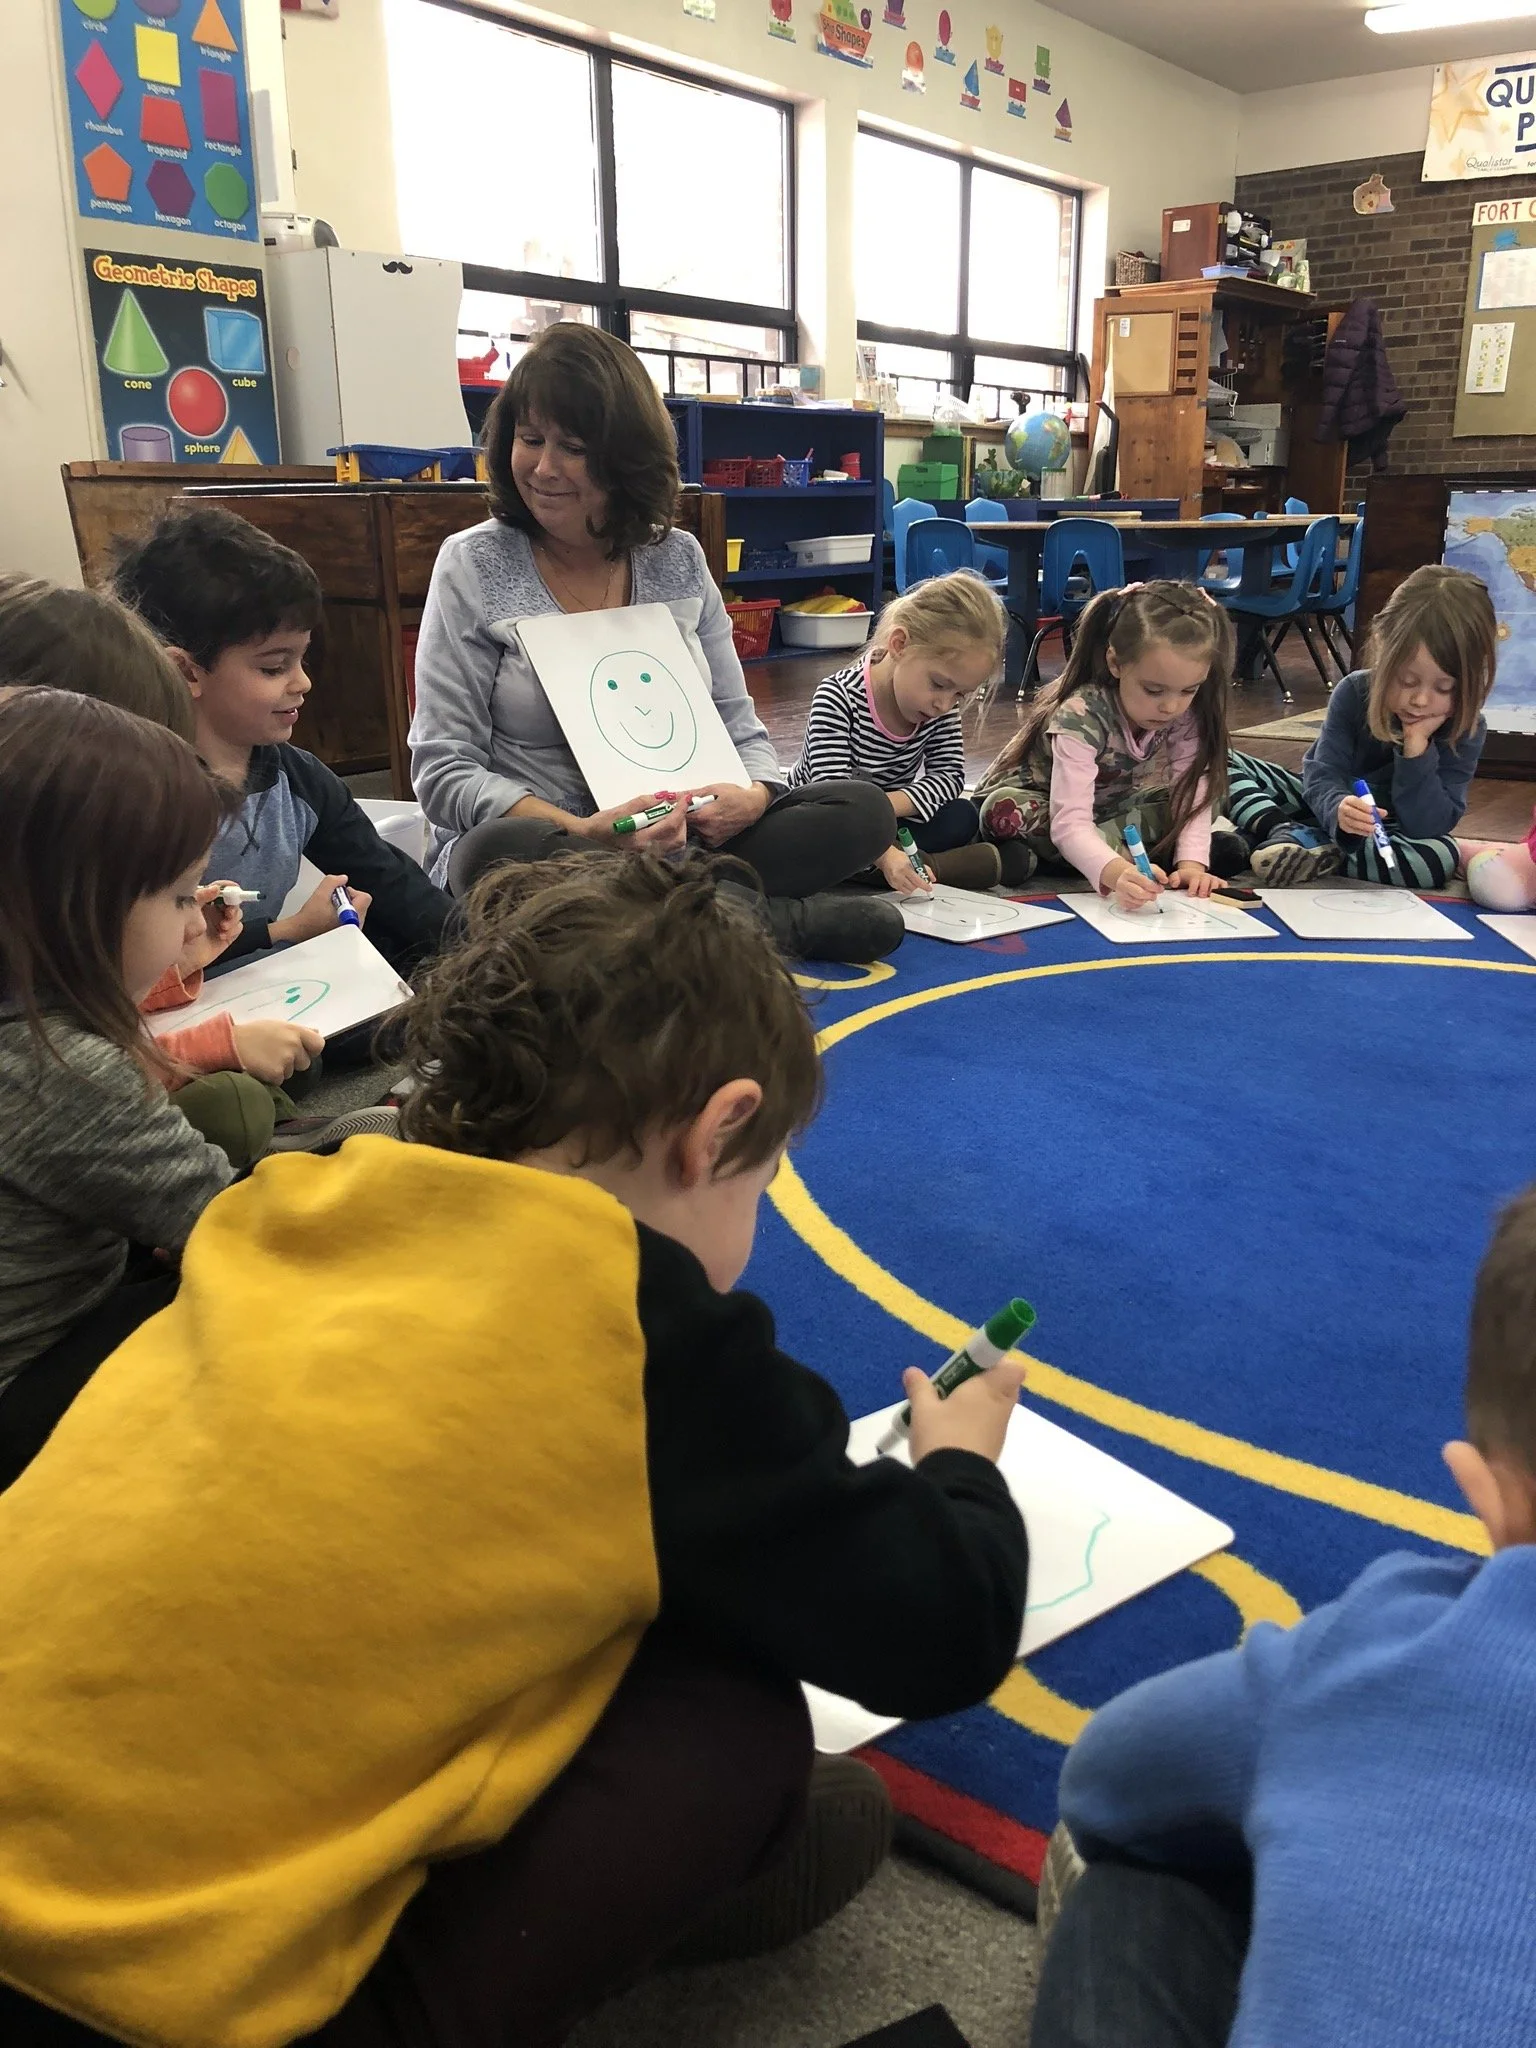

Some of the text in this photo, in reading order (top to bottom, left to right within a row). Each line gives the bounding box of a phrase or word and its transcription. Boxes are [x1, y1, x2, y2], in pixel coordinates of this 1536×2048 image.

[82, 20, 108, 34] circle
[147, 16, 165, 28] oval
[836, 23, 866, 49] Shapes
[200, 47, 232, 62] triangle
[146, 83, 175, 96] square
[1486, 75, 1535, 108] QU
[85, 120, 124, 136] rhombus
[1518, 112, 1535, 141] P
[147, 143, 188, 160] trapezoid
[204, 141, 242, 156] rectangle
[90, 199, 132, 213] pentagon
[1478, 201, 1522, 222] FORT
[155, 212, 191, 226] hexagon
[214, 218, 247, 232] octagon
[93, 255, 256, 301] Geometric Shapes
[124, 379, 152, 390] cone
[232, 377, 257, 388] cube
[184, 443, 221, 455] sphere
